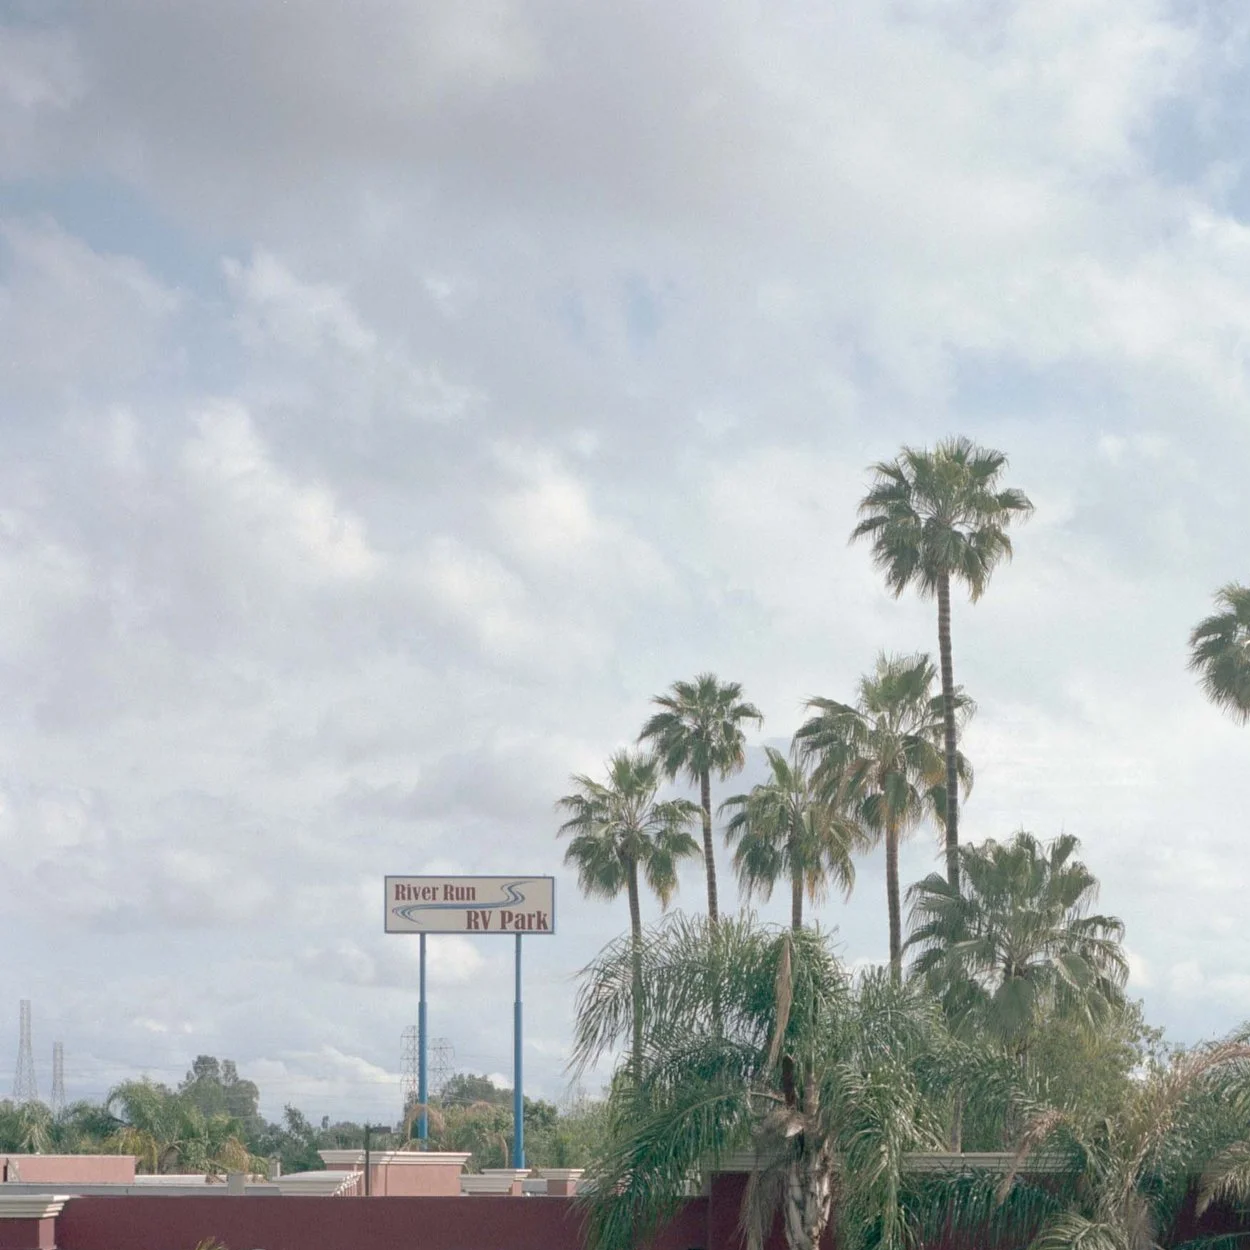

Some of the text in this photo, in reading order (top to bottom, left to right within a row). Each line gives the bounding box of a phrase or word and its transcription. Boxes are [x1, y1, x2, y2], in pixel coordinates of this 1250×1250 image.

[394, 883, 476, 901] River Run
[465, 910, 549, 930] RV Park
